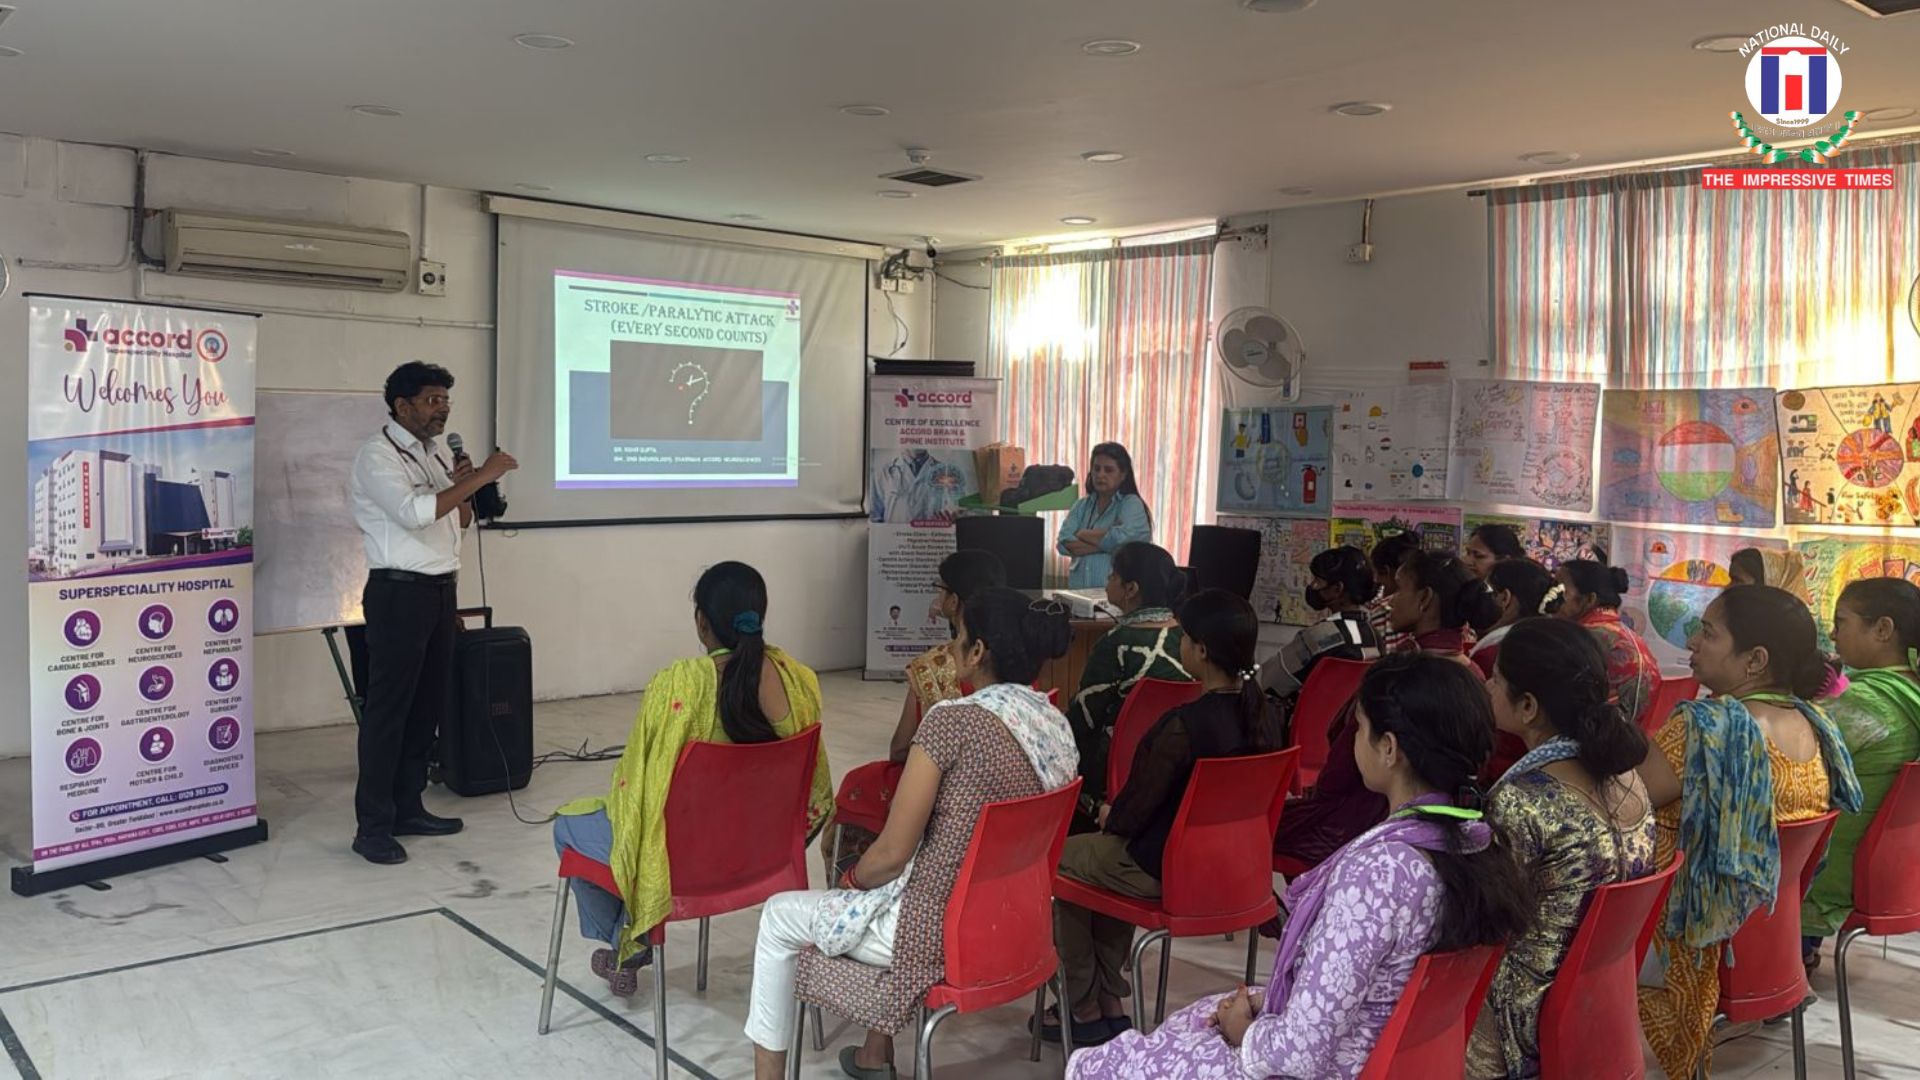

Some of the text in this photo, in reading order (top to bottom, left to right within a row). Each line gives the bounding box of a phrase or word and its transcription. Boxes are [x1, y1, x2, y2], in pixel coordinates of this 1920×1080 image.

[584, 299, 775, 328] STROKE /PARALYTIC ATTACK
[610, 319, 768, 345] (EVERY SECOND COUNTS)
[103, 328, 192, 350] accord
[64, 368, 229, 416] Welcomes You
[917, 390, 972, 403] accord
[885, 417, 981, 428] CENTRE OF EXCELLENCE
[899, 427, 933, 436] ACCORD
[933, 428, 958, 436] BRAIN
[900, 437, 966, 446] SPINE INSTITUTE
[59, 578, 234, 600] SUPERSPECIALITY HOSPITAL
[204, 637, 242, 648] CENTRE FOR
[135, 644, 176, 655] CENTRE FOR
[60, 651, 104, 664] CENTRE FOR
[128, 652, 183, 664] NEUROSCIENCES
[47, 659, 115, 672] CARDIAC SCIENCES
[205, 696, 242, 707] CENTRE FOR
[135, 705, 176, 717] CENTRE FOR
[61, 715, 105, 728] CENTRE FOR
[56, 722, 109, 736] BONE & JOINTS
[136, 765, 177, 779] CENTRE FOR
[59, 777, 108, 792] RESPIRATORY
[129, 776, 157, 787] MOTHER
[67, 787, 99, 799] MEDICINE
[82, 808, 98, 818] FOR
